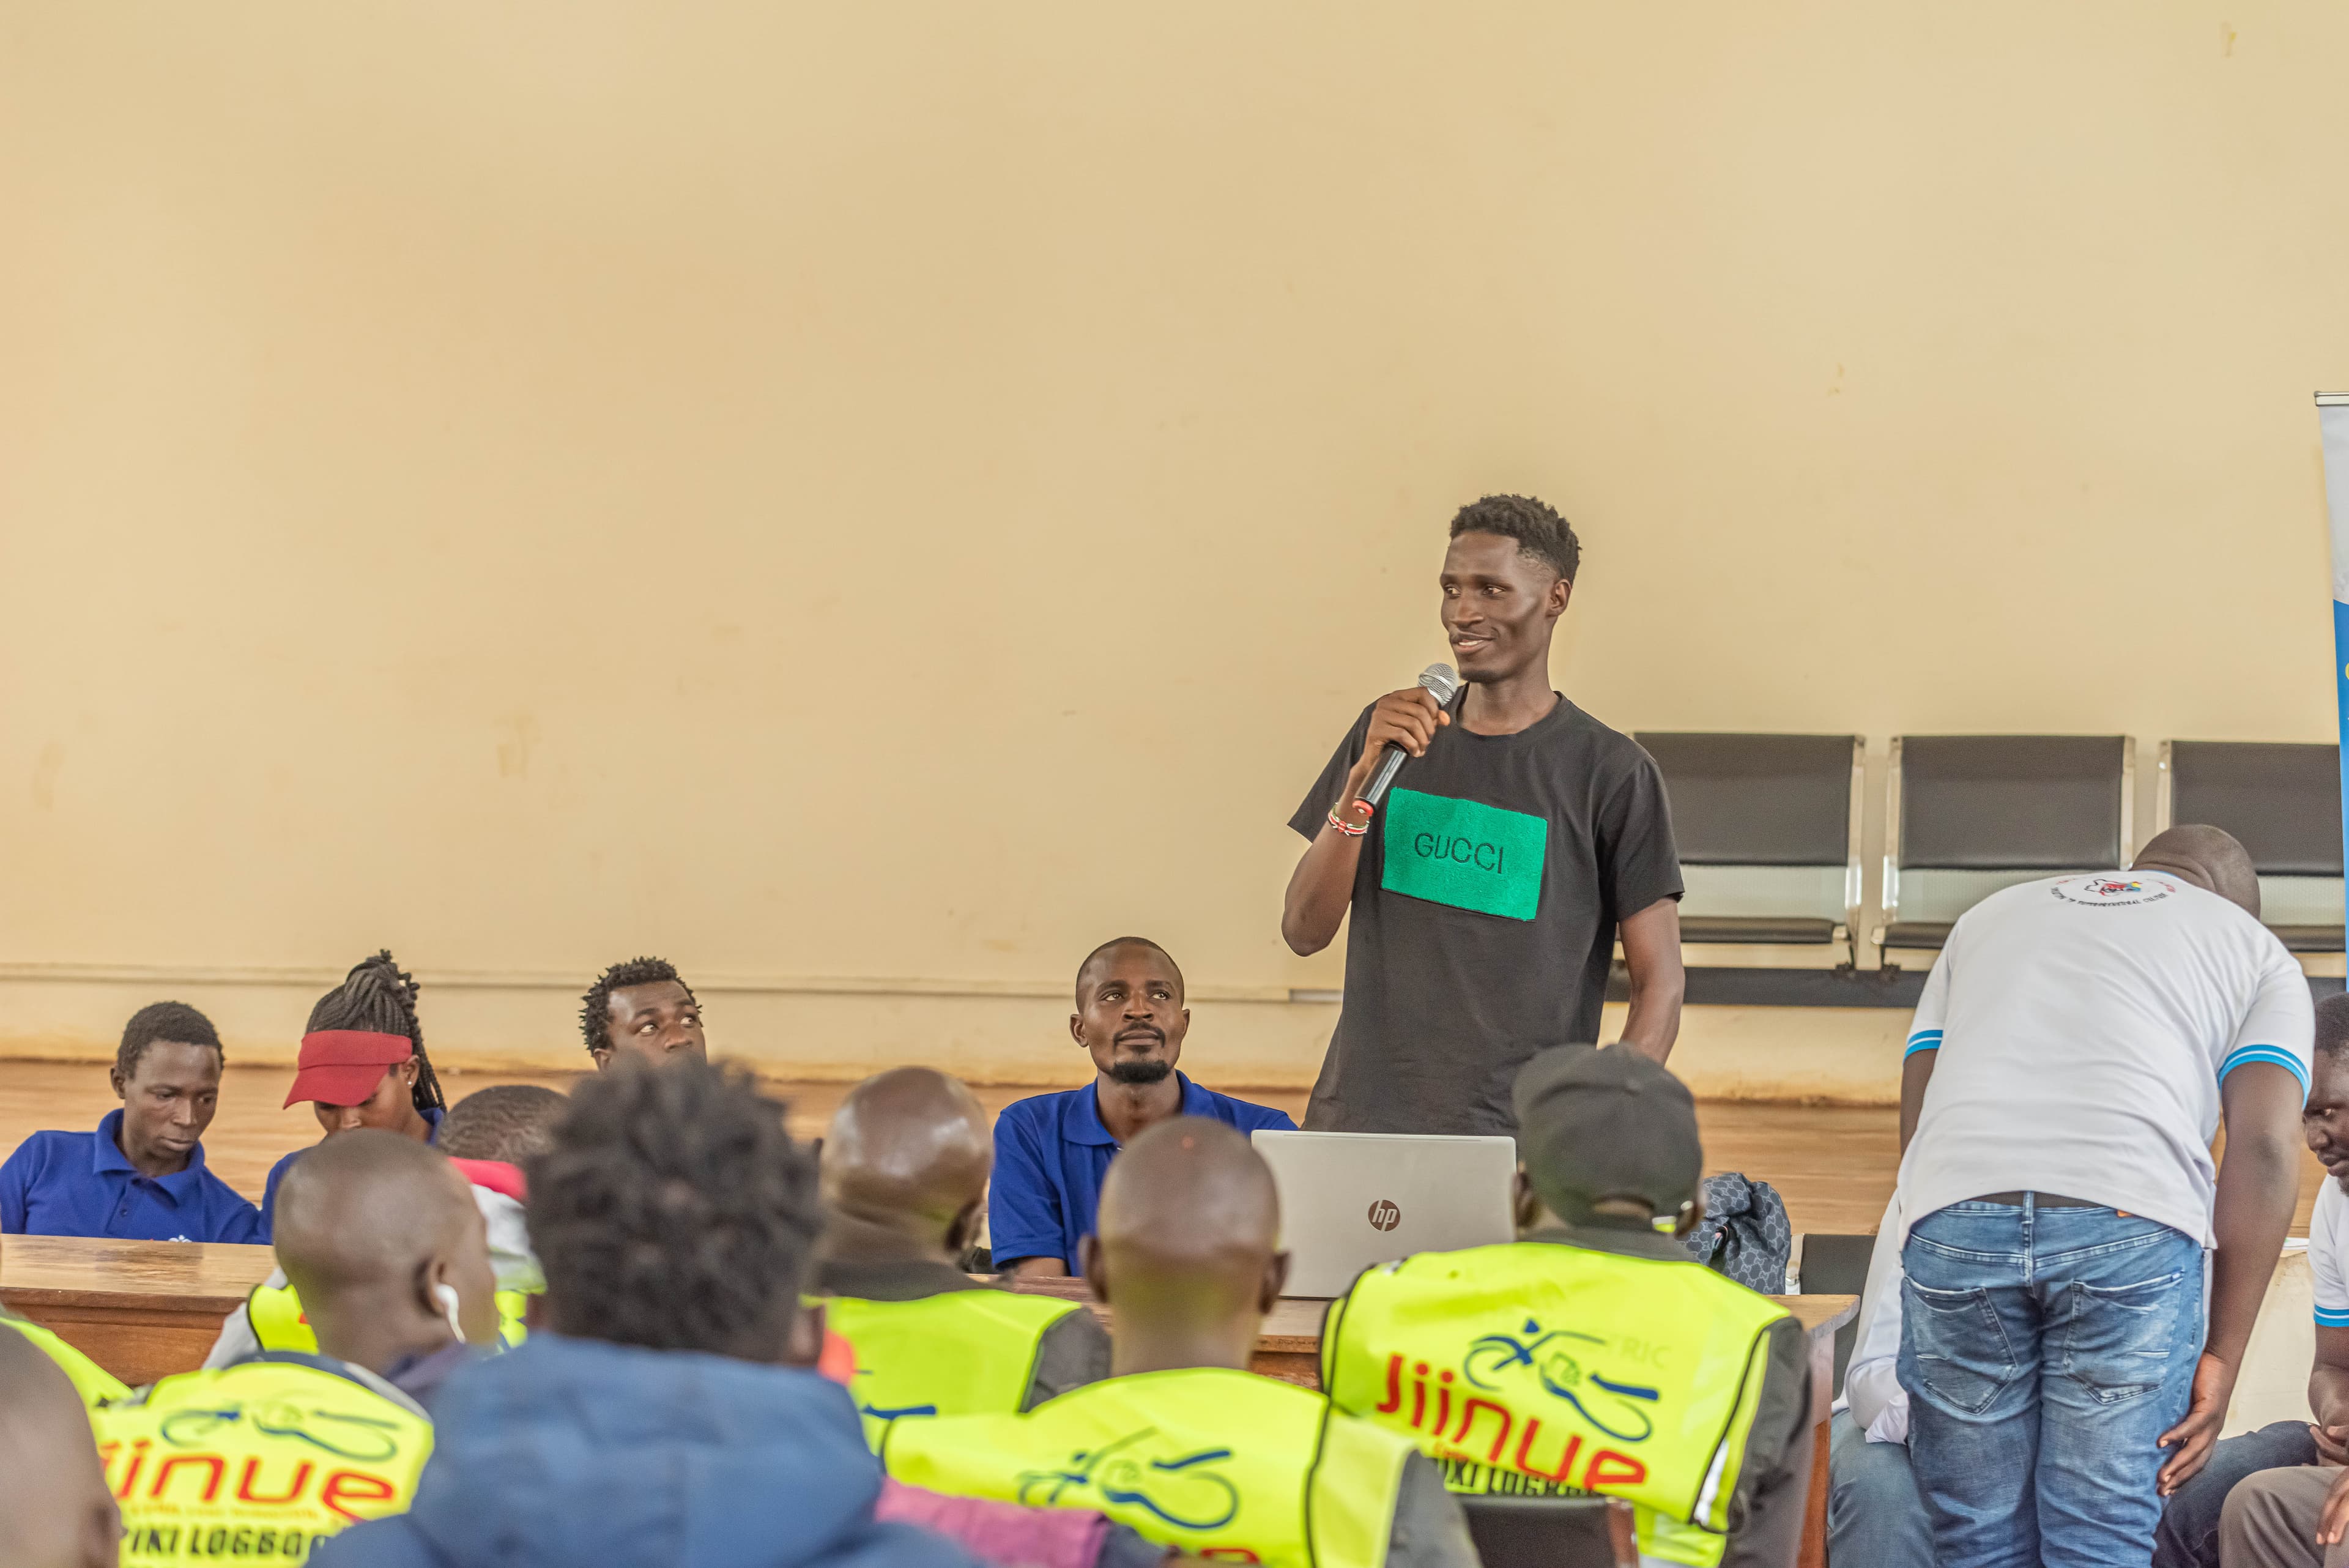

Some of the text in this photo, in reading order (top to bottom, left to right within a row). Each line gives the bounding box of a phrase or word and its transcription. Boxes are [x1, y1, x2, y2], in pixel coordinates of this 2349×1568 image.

[1414, 833, 1504, 874] GUCCI
[1371, 1200, 1398, 1232] hp
[1376, 1353, 1647, 1490] Jiinue
